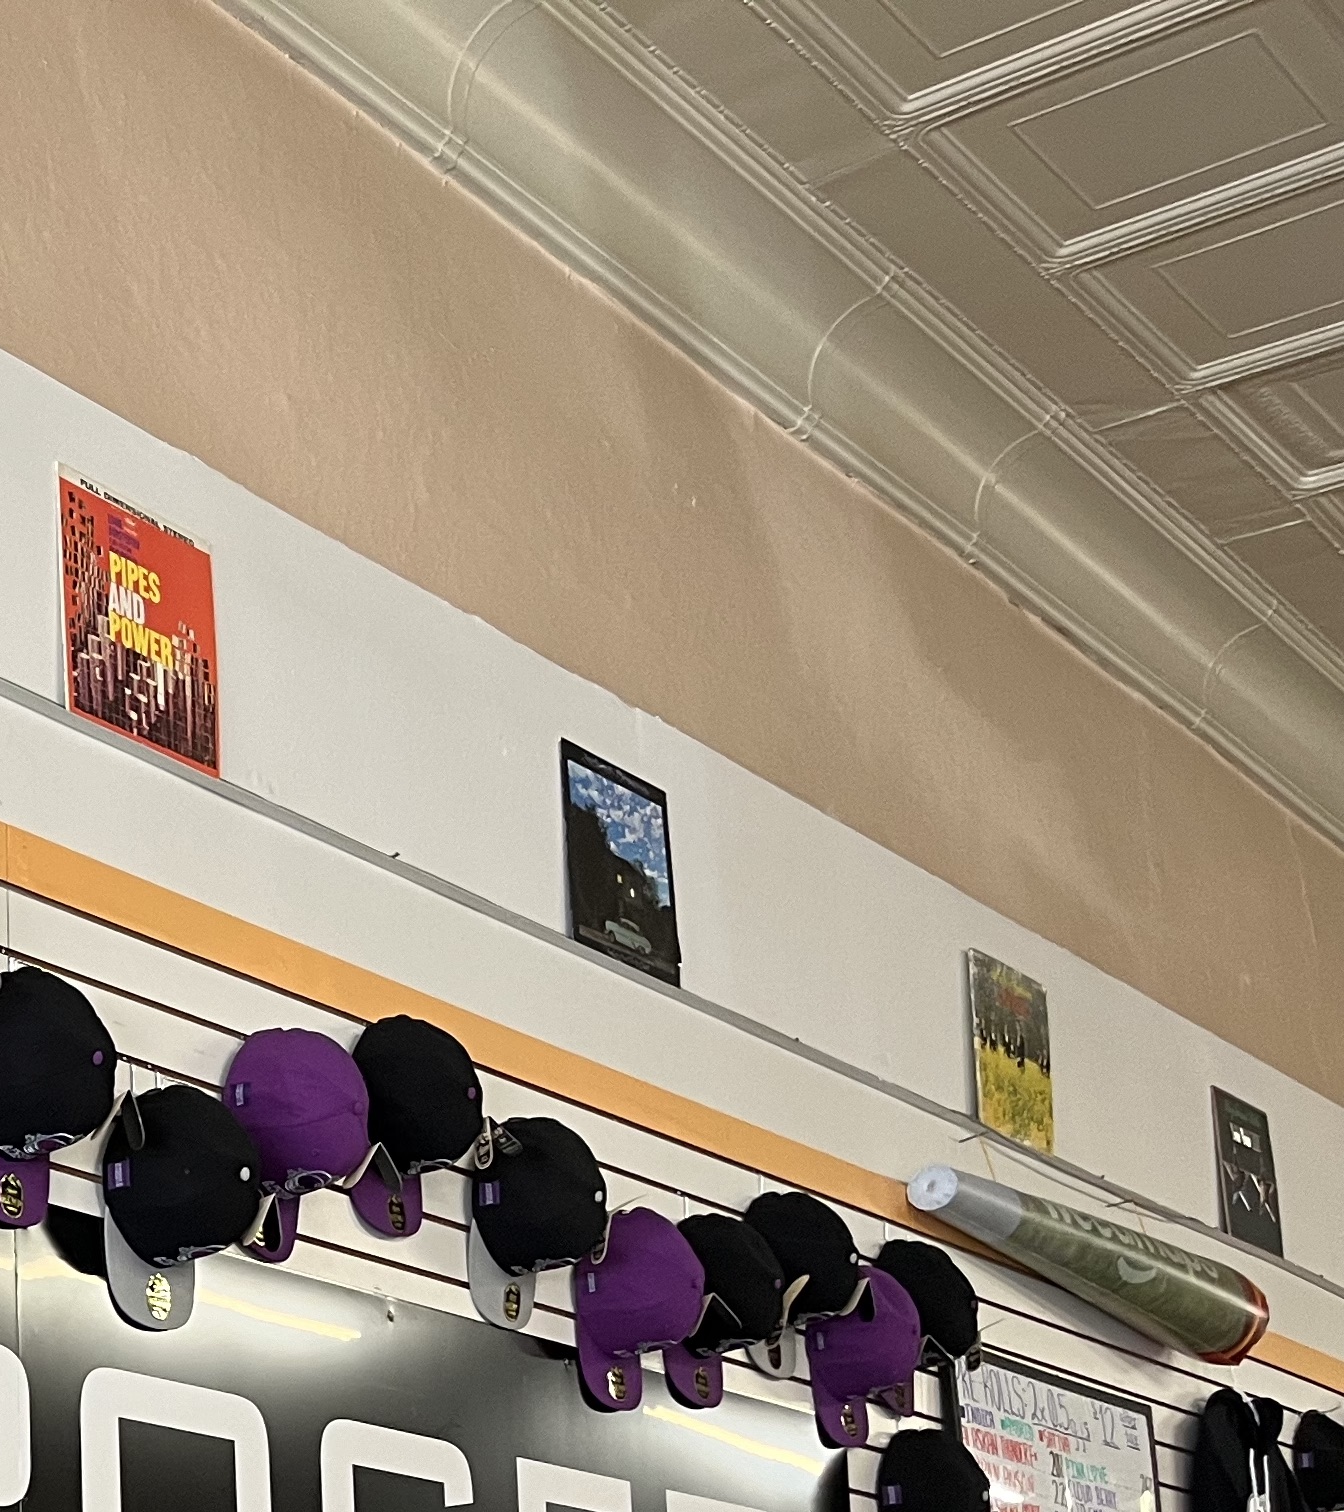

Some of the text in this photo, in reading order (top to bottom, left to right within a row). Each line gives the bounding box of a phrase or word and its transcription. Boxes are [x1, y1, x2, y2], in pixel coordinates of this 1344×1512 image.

[79, 478, 101, 496] FULL
[109, 551, 161, 604] PIPES
[109, 582, 146, 625] AND
[109, 611, 174, 670] POWER
